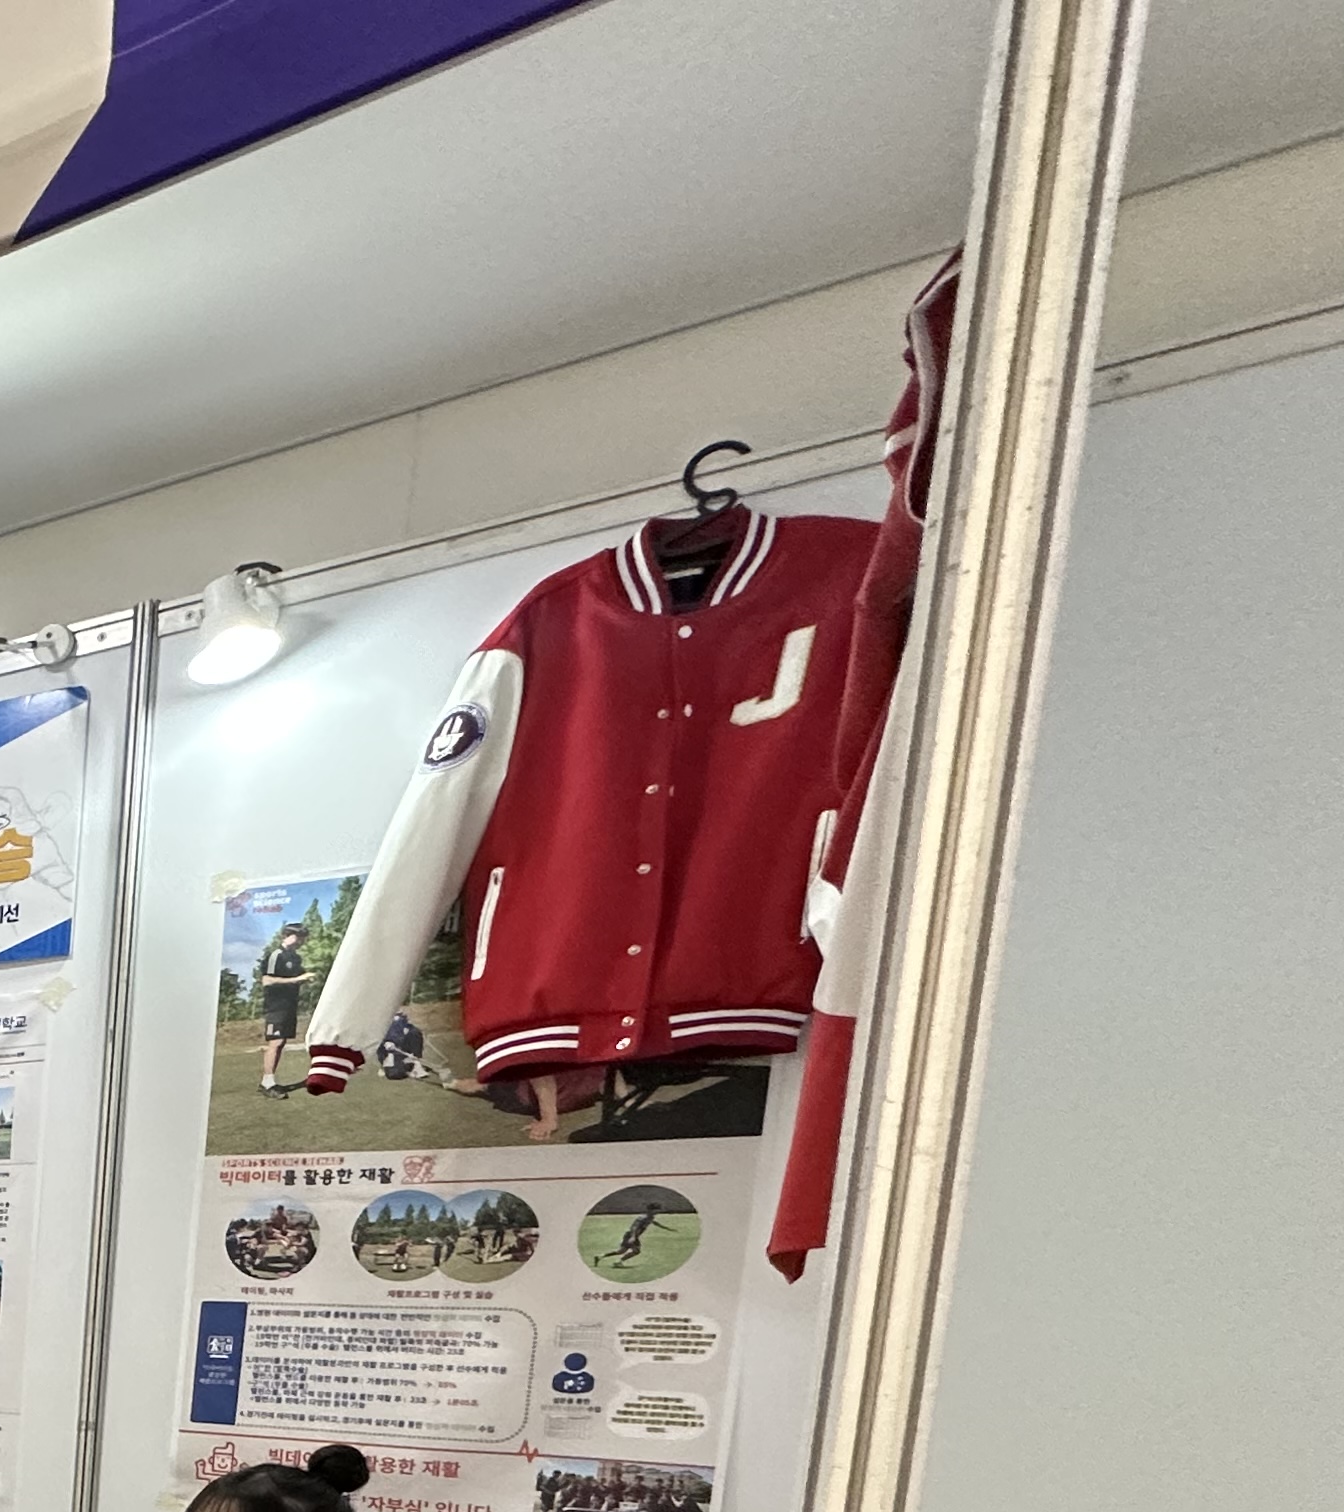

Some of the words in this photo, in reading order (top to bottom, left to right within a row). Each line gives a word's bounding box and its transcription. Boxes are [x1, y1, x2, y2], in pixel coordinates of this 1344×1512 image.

[729, 623, 818, 727] J
[219, 1169, 297, 1186] 빅데이터를
[303, 1168, 353, 1185] 활용한
[359, 1167, 395, 1184] 재활
[422, 1460, 461, 1479] 재활
